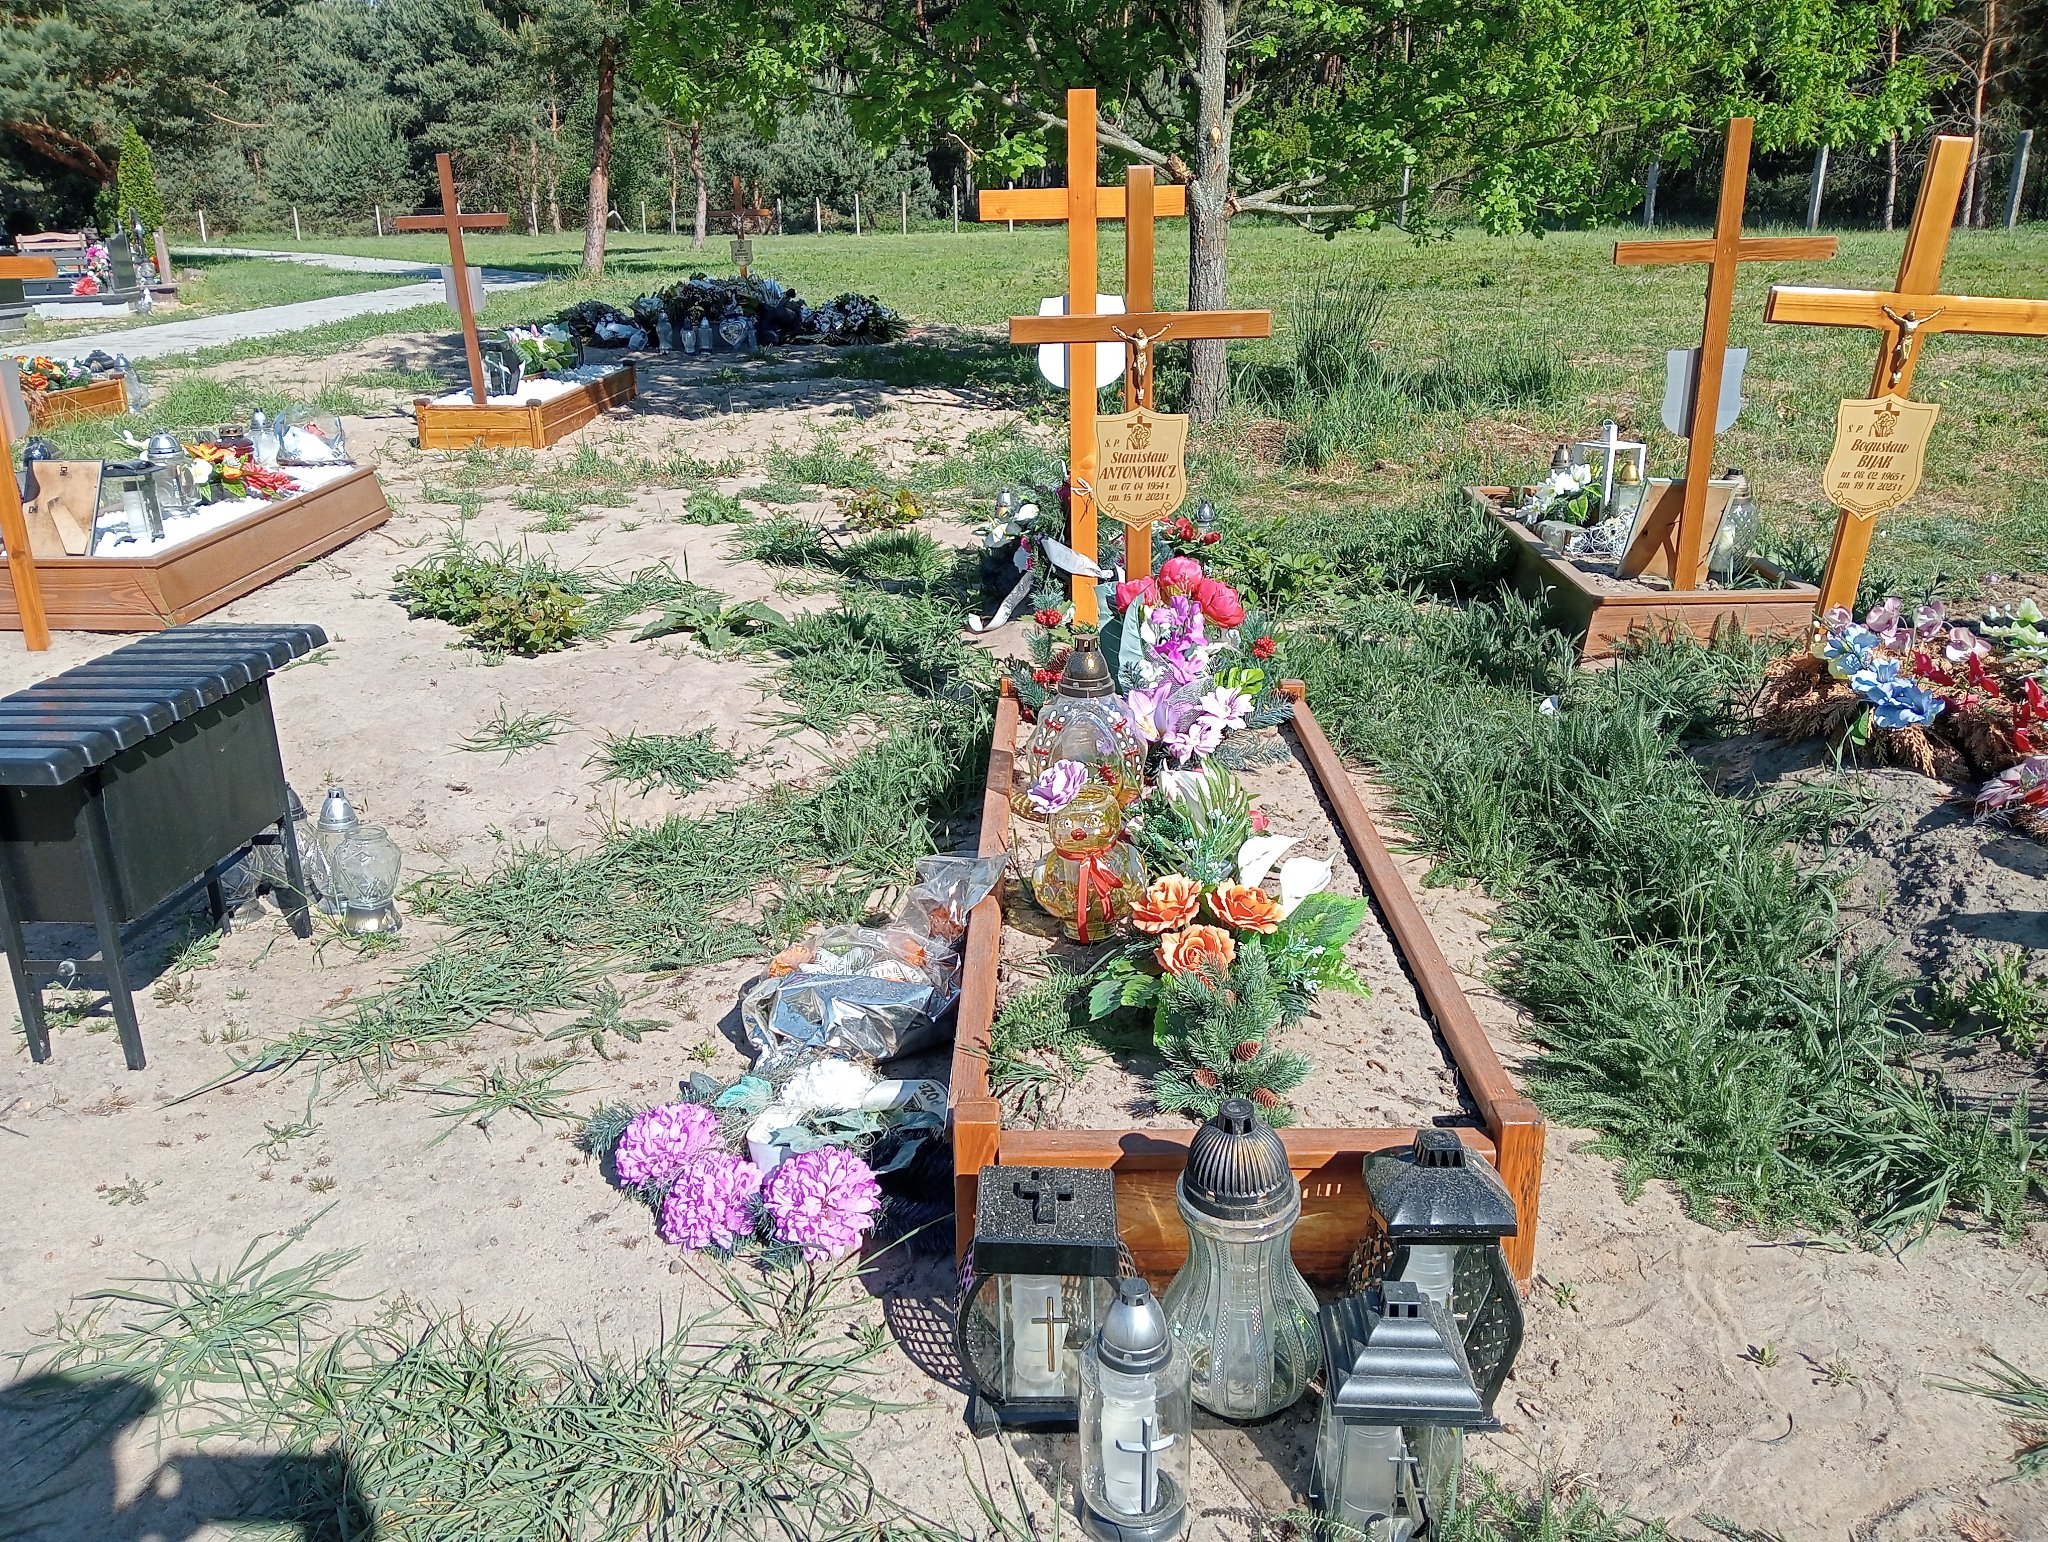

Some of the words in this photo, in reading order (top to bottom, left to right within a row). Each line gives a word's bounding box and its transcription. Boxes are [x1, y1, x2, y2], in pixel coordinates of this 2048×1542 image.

[1851, 438, 1910, 454] Bogusław
[1111, 451, 1169, 464] Stanisław
[1857, 455, 1893, 470] BIJAK
[1099, 465, 1177, 480] ANTONOWICZ
[1881, 472, 1900, 481] 1965
[1147, 481, 1164, 490] 1954
[1877, 482, 1897, 491] 2023
[1145, 492, 1164, 501] 2023
[919, 1081, 944, 1106] POŻE
